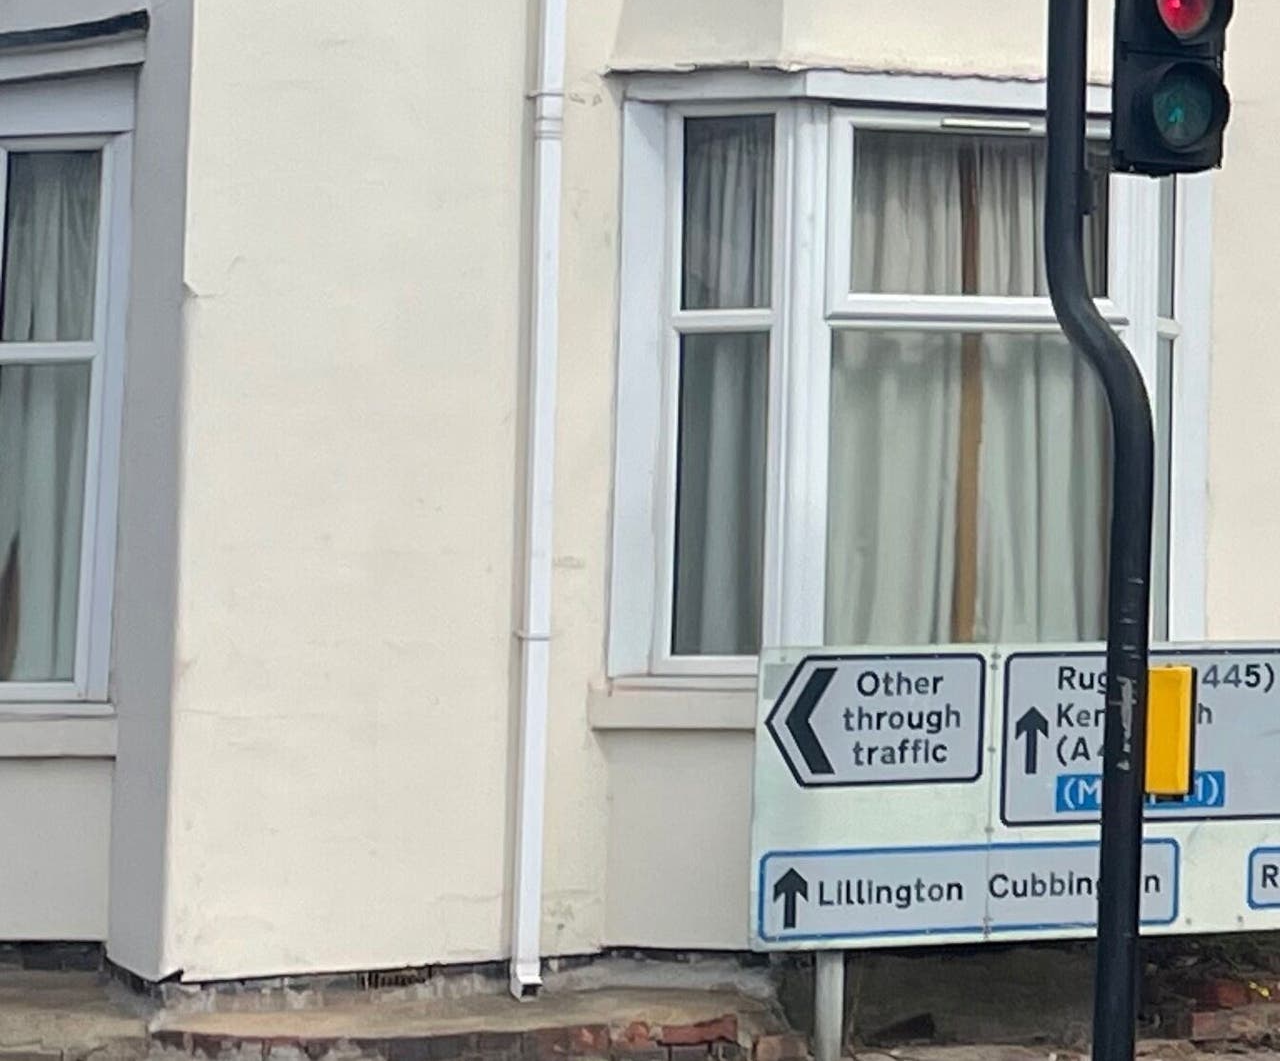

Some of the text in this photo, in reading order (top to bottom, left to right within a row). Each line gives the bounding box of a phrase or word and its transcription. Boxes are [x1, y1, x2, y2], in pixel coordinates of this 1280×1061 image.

[857, 671, 944, 697] Other
[843, 703, 961, 734] through
[853, 738, 948, 766] traffic
[819, 870, 1161, 909] Lillington Cubbinn
